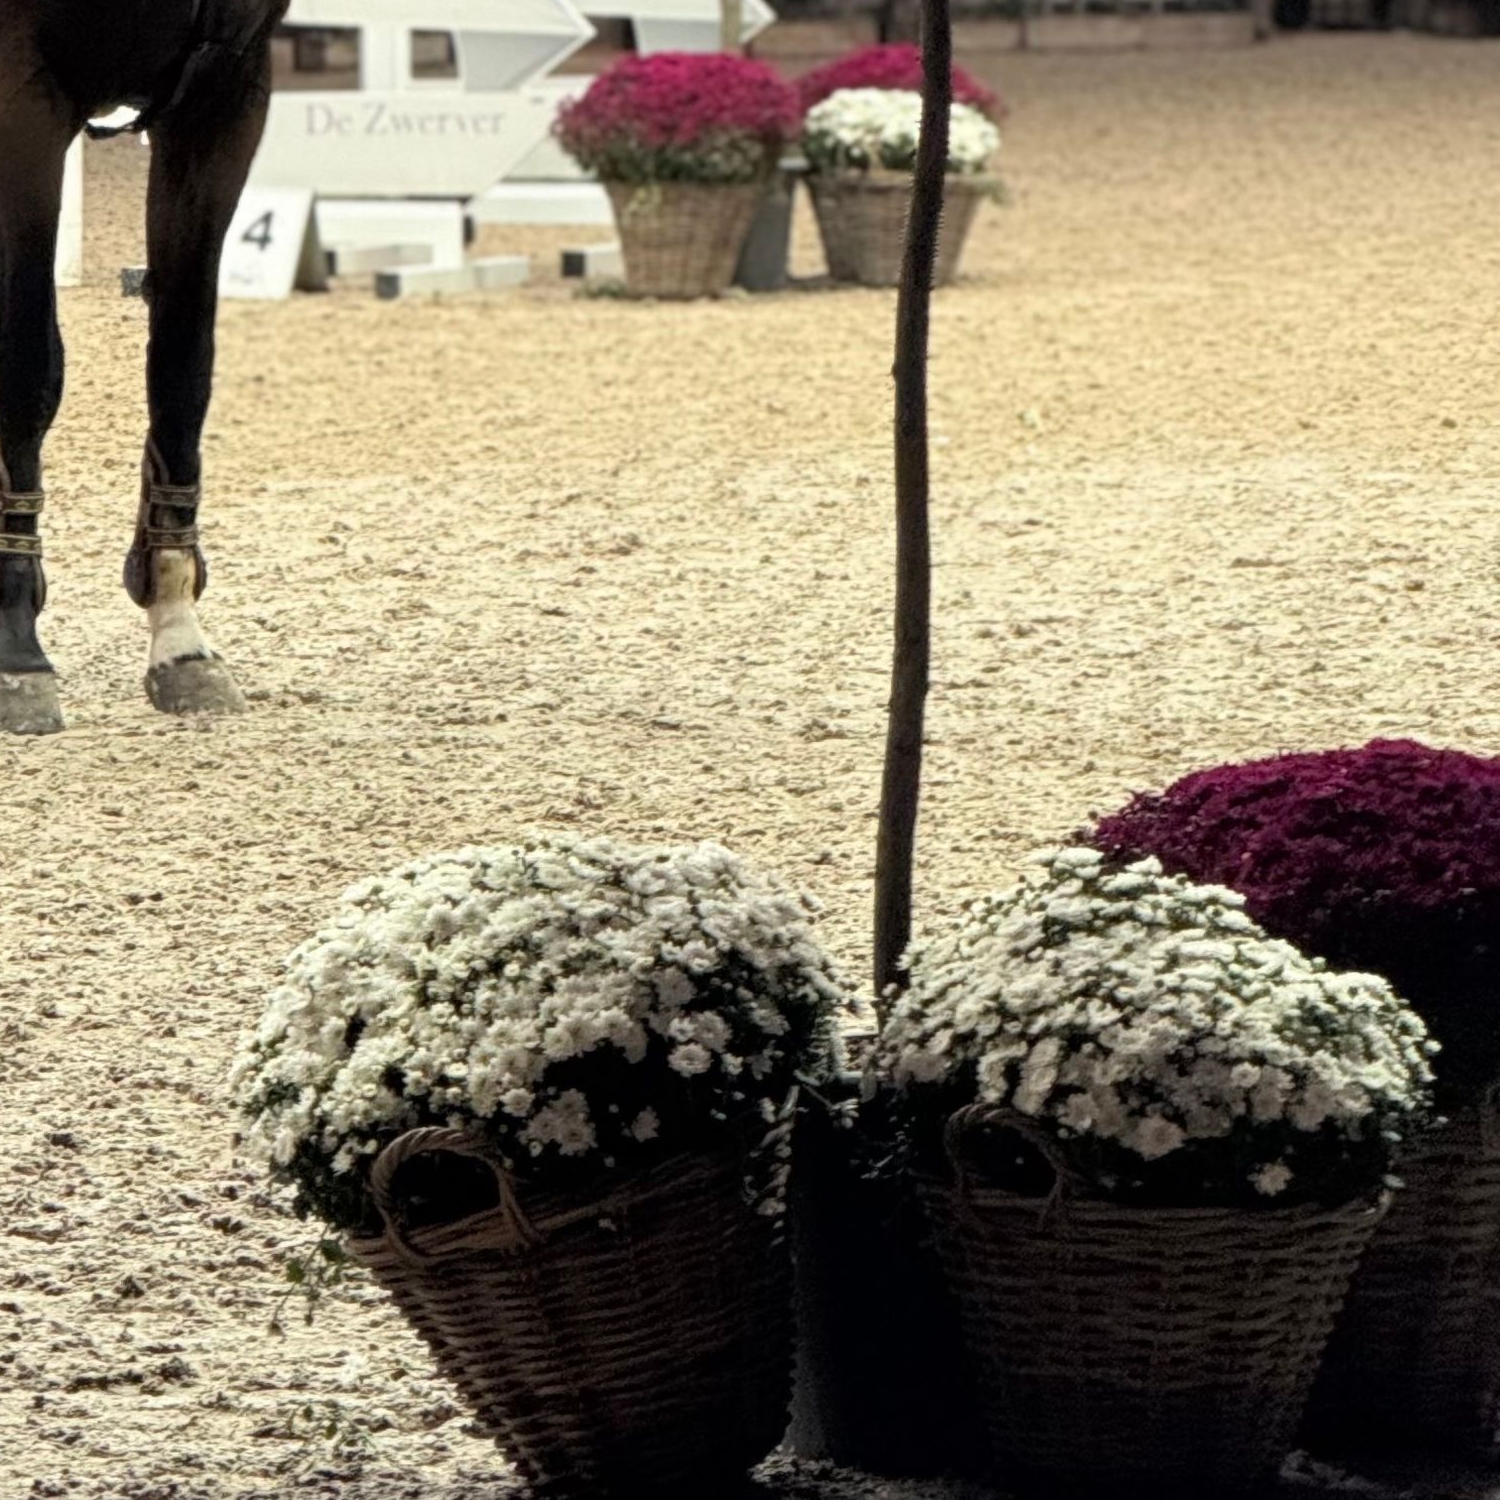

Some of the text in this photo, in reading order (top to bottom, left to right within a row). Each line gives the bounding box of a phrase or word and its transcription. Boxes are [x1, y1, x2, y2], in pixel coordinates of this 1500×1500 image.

[305, 103, 504, 137] De Zwerver
[241, 209, 274, 252] 4
